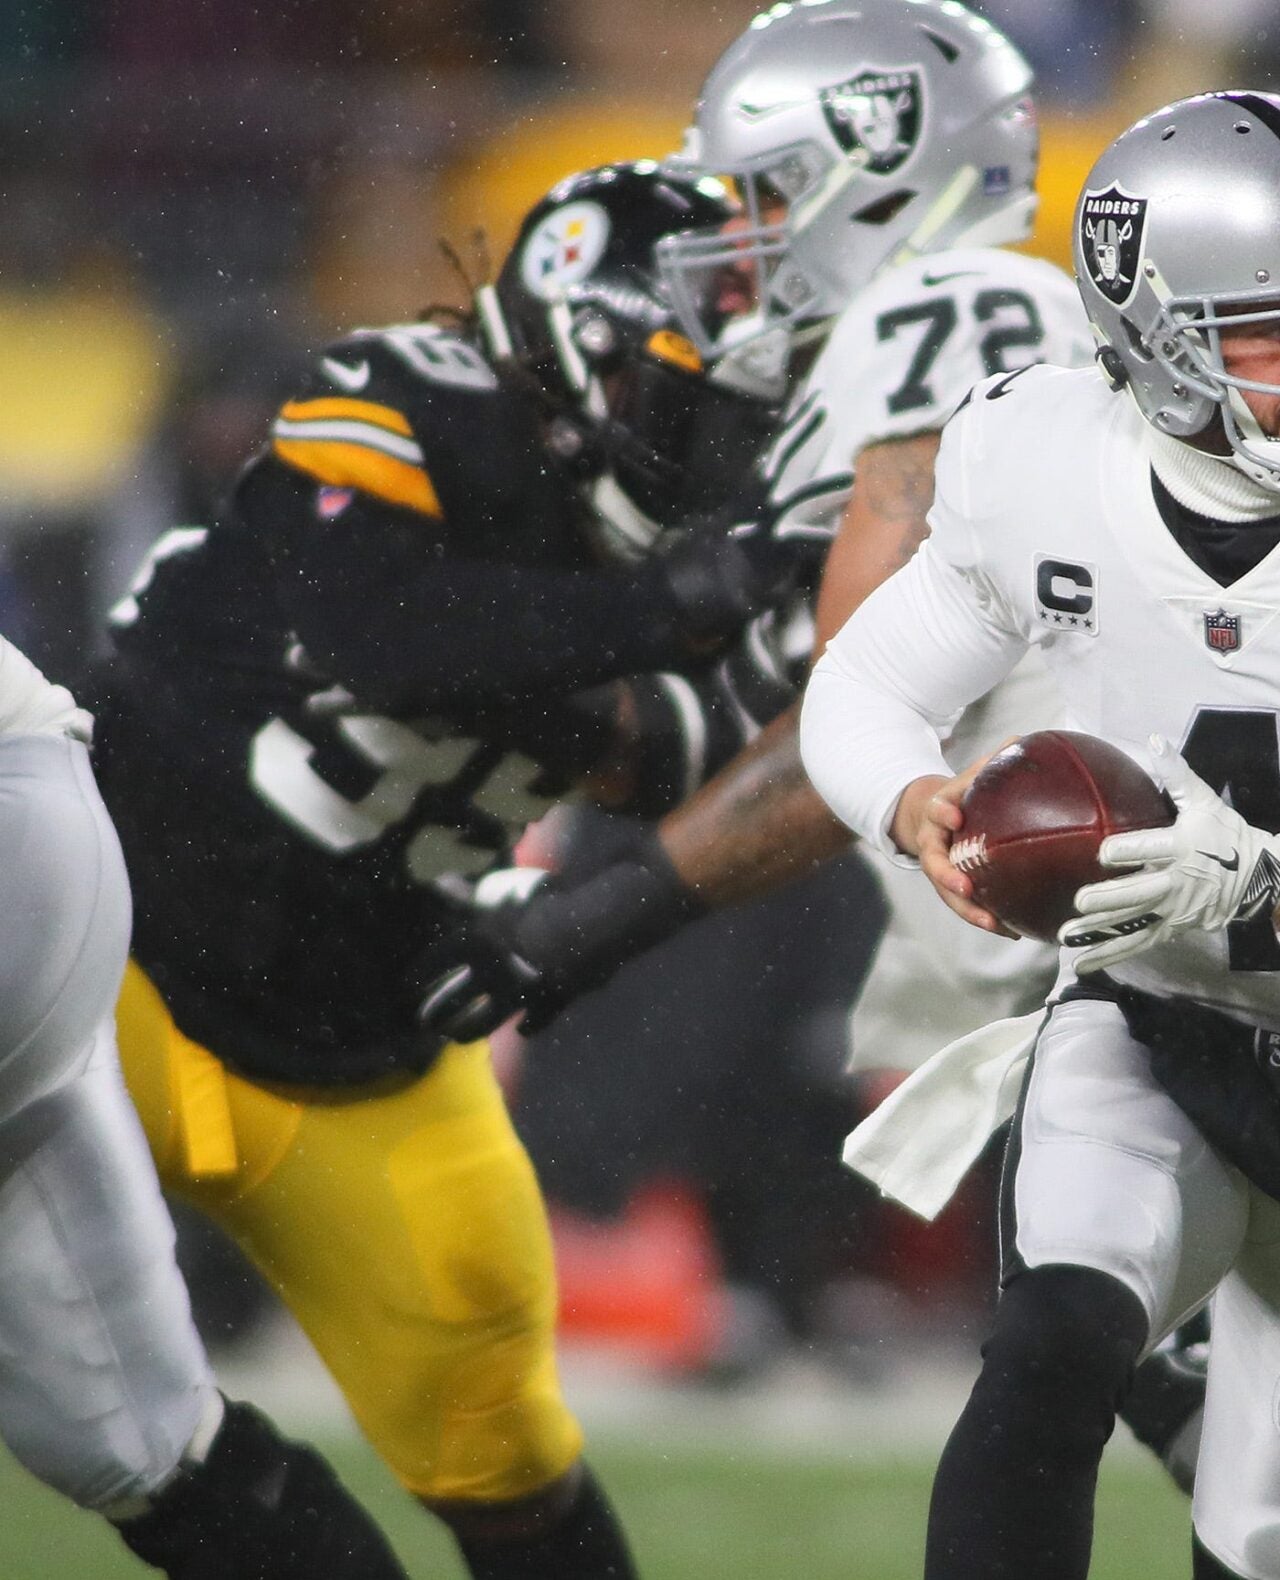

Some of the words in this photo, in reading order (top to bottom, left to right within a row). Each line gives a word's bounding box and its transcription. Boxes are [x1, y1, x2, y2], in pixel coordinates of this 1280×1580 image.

[1086, 199, 1140, 215] RAIDERS
[876, 289, 1045, 416] 72
[1037, 559, 1093, 615] C
[1209, 628, 1236, 648] NFL
